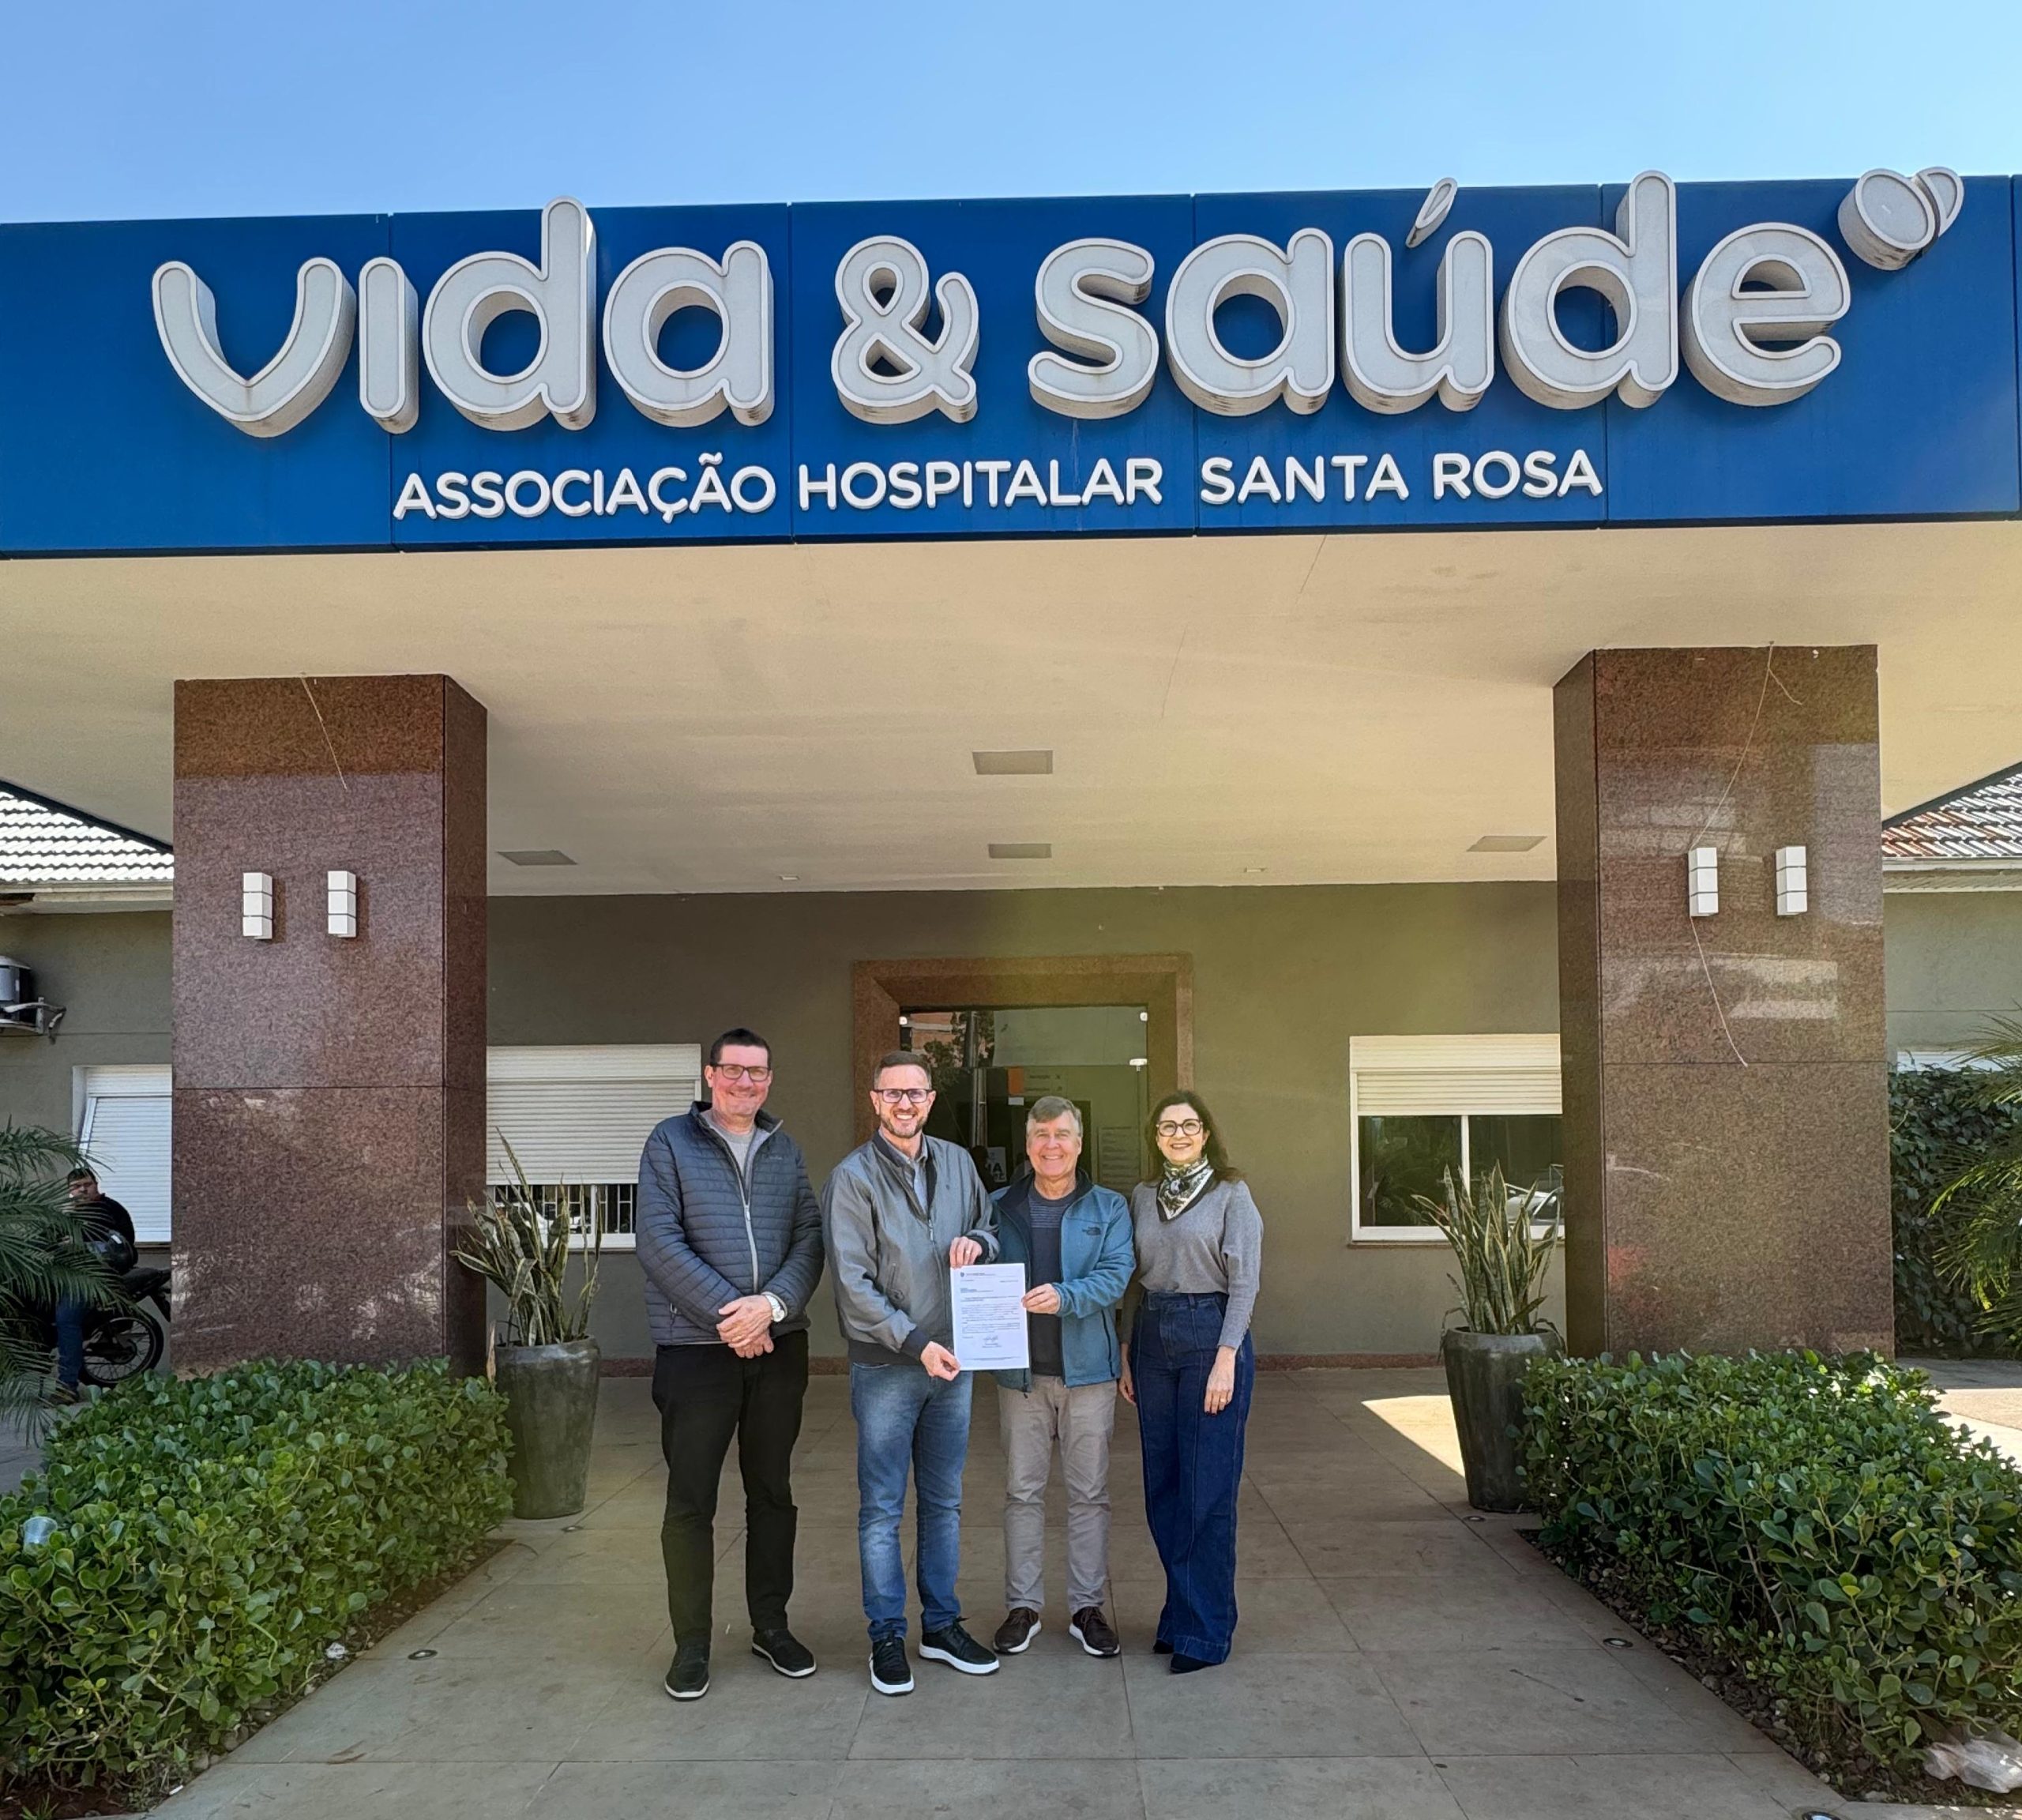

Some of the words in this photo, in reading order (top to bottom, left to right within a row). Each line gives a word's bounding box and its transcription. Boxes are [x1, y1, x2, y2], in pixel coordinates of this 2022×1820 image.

[152, 196, 774, 438] vida
[831, 235, 979, 424] &
[1028, 170, 1851, 419] saúde
[393, 452, 776, 524] ASSOCIAÇÃO
[799, 458, 1163, 510] HOSPITALAR
[1200, 453, 1410, 505] SANTA
[1433, 449, 1603, 500] ROSA
